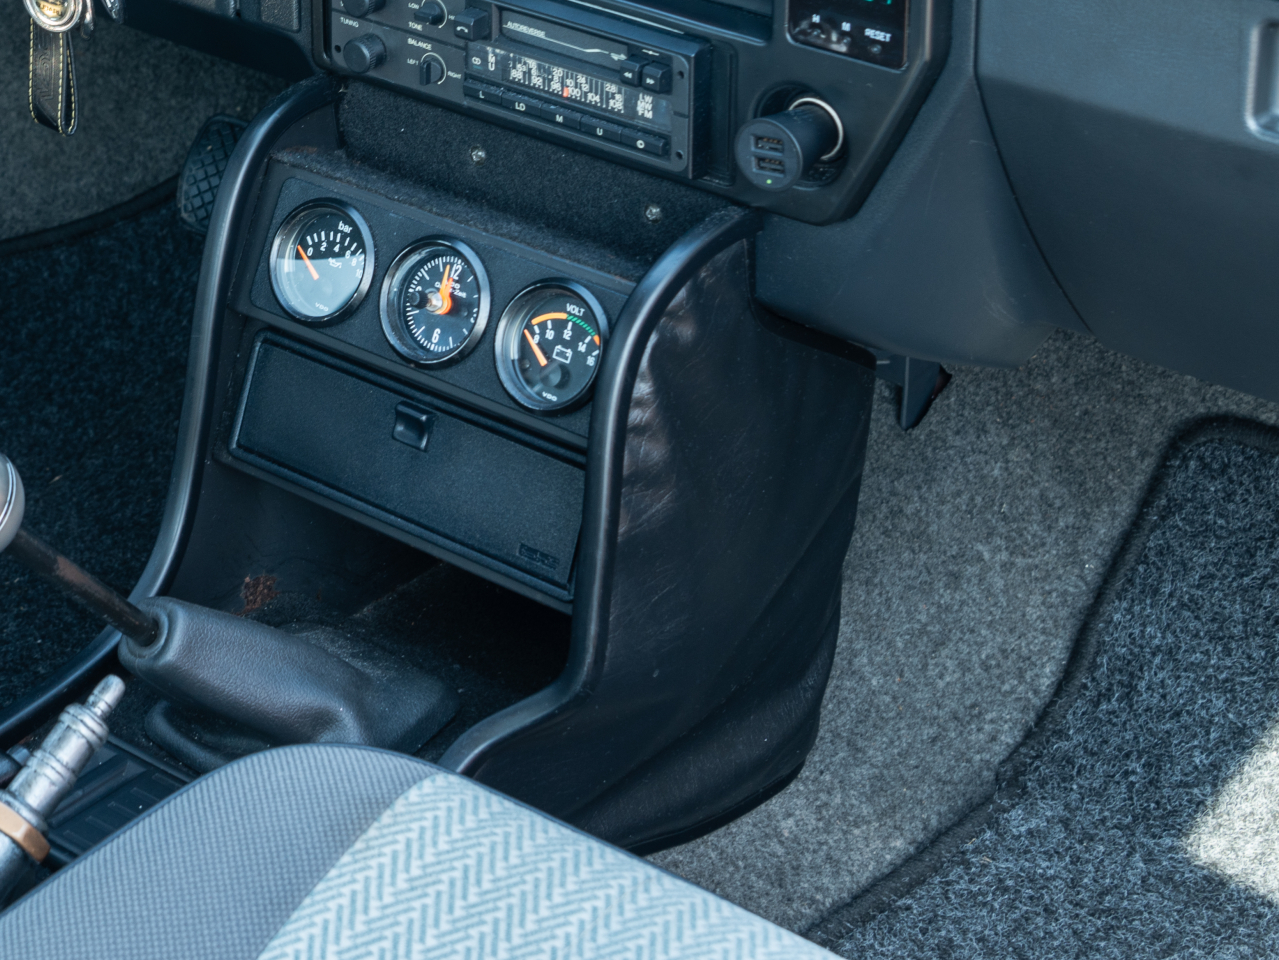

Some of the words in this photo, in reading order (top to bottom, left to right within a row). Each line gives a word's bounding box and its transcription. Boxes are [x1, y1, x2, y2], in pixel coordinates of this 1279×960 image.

[408, 2, 419, 10] LOW
[340, 17, 359, 28] TUNING
[408, 21, 423, 31] TONE
[506, 21, 546, 39] AUTOREVERSE
[864, 28, 892, 43] RESET
[407, 38, 432, 51] BALANCE
[407, 58, 419, 66] LEFT
[447, 70, 462, 80] RIGHT
[576, 75, 586, 84] 24
[605, 83, 617, 93] 28
[639, 92, 653, 104] LW
[638, 109, 653, 119] FM
[596, 127, 603, 136] U
[338, 220, 353, 234] bar
[307, 247, 313, 256] 0
[320, 242, 328, 251] 2
[333, 243, 340, 253] 4
[345, 250, 351, 259] 6
[351, 257, 357, 267] 8
[355, 268, 363, 279] 10
[451, 263, 463, 280] 12
[315, 302, 329, 312] VDO
[566, 303, 585, 317] VOLT
[431, 328, 441, 343] 6
[545, 329, 555, 340] 10
[563, 329, 572, 340] 12
[578, 341, 587, 353] 14
[586, 355, 595, 367] 16
[542, 391, 558, 402] VDO
